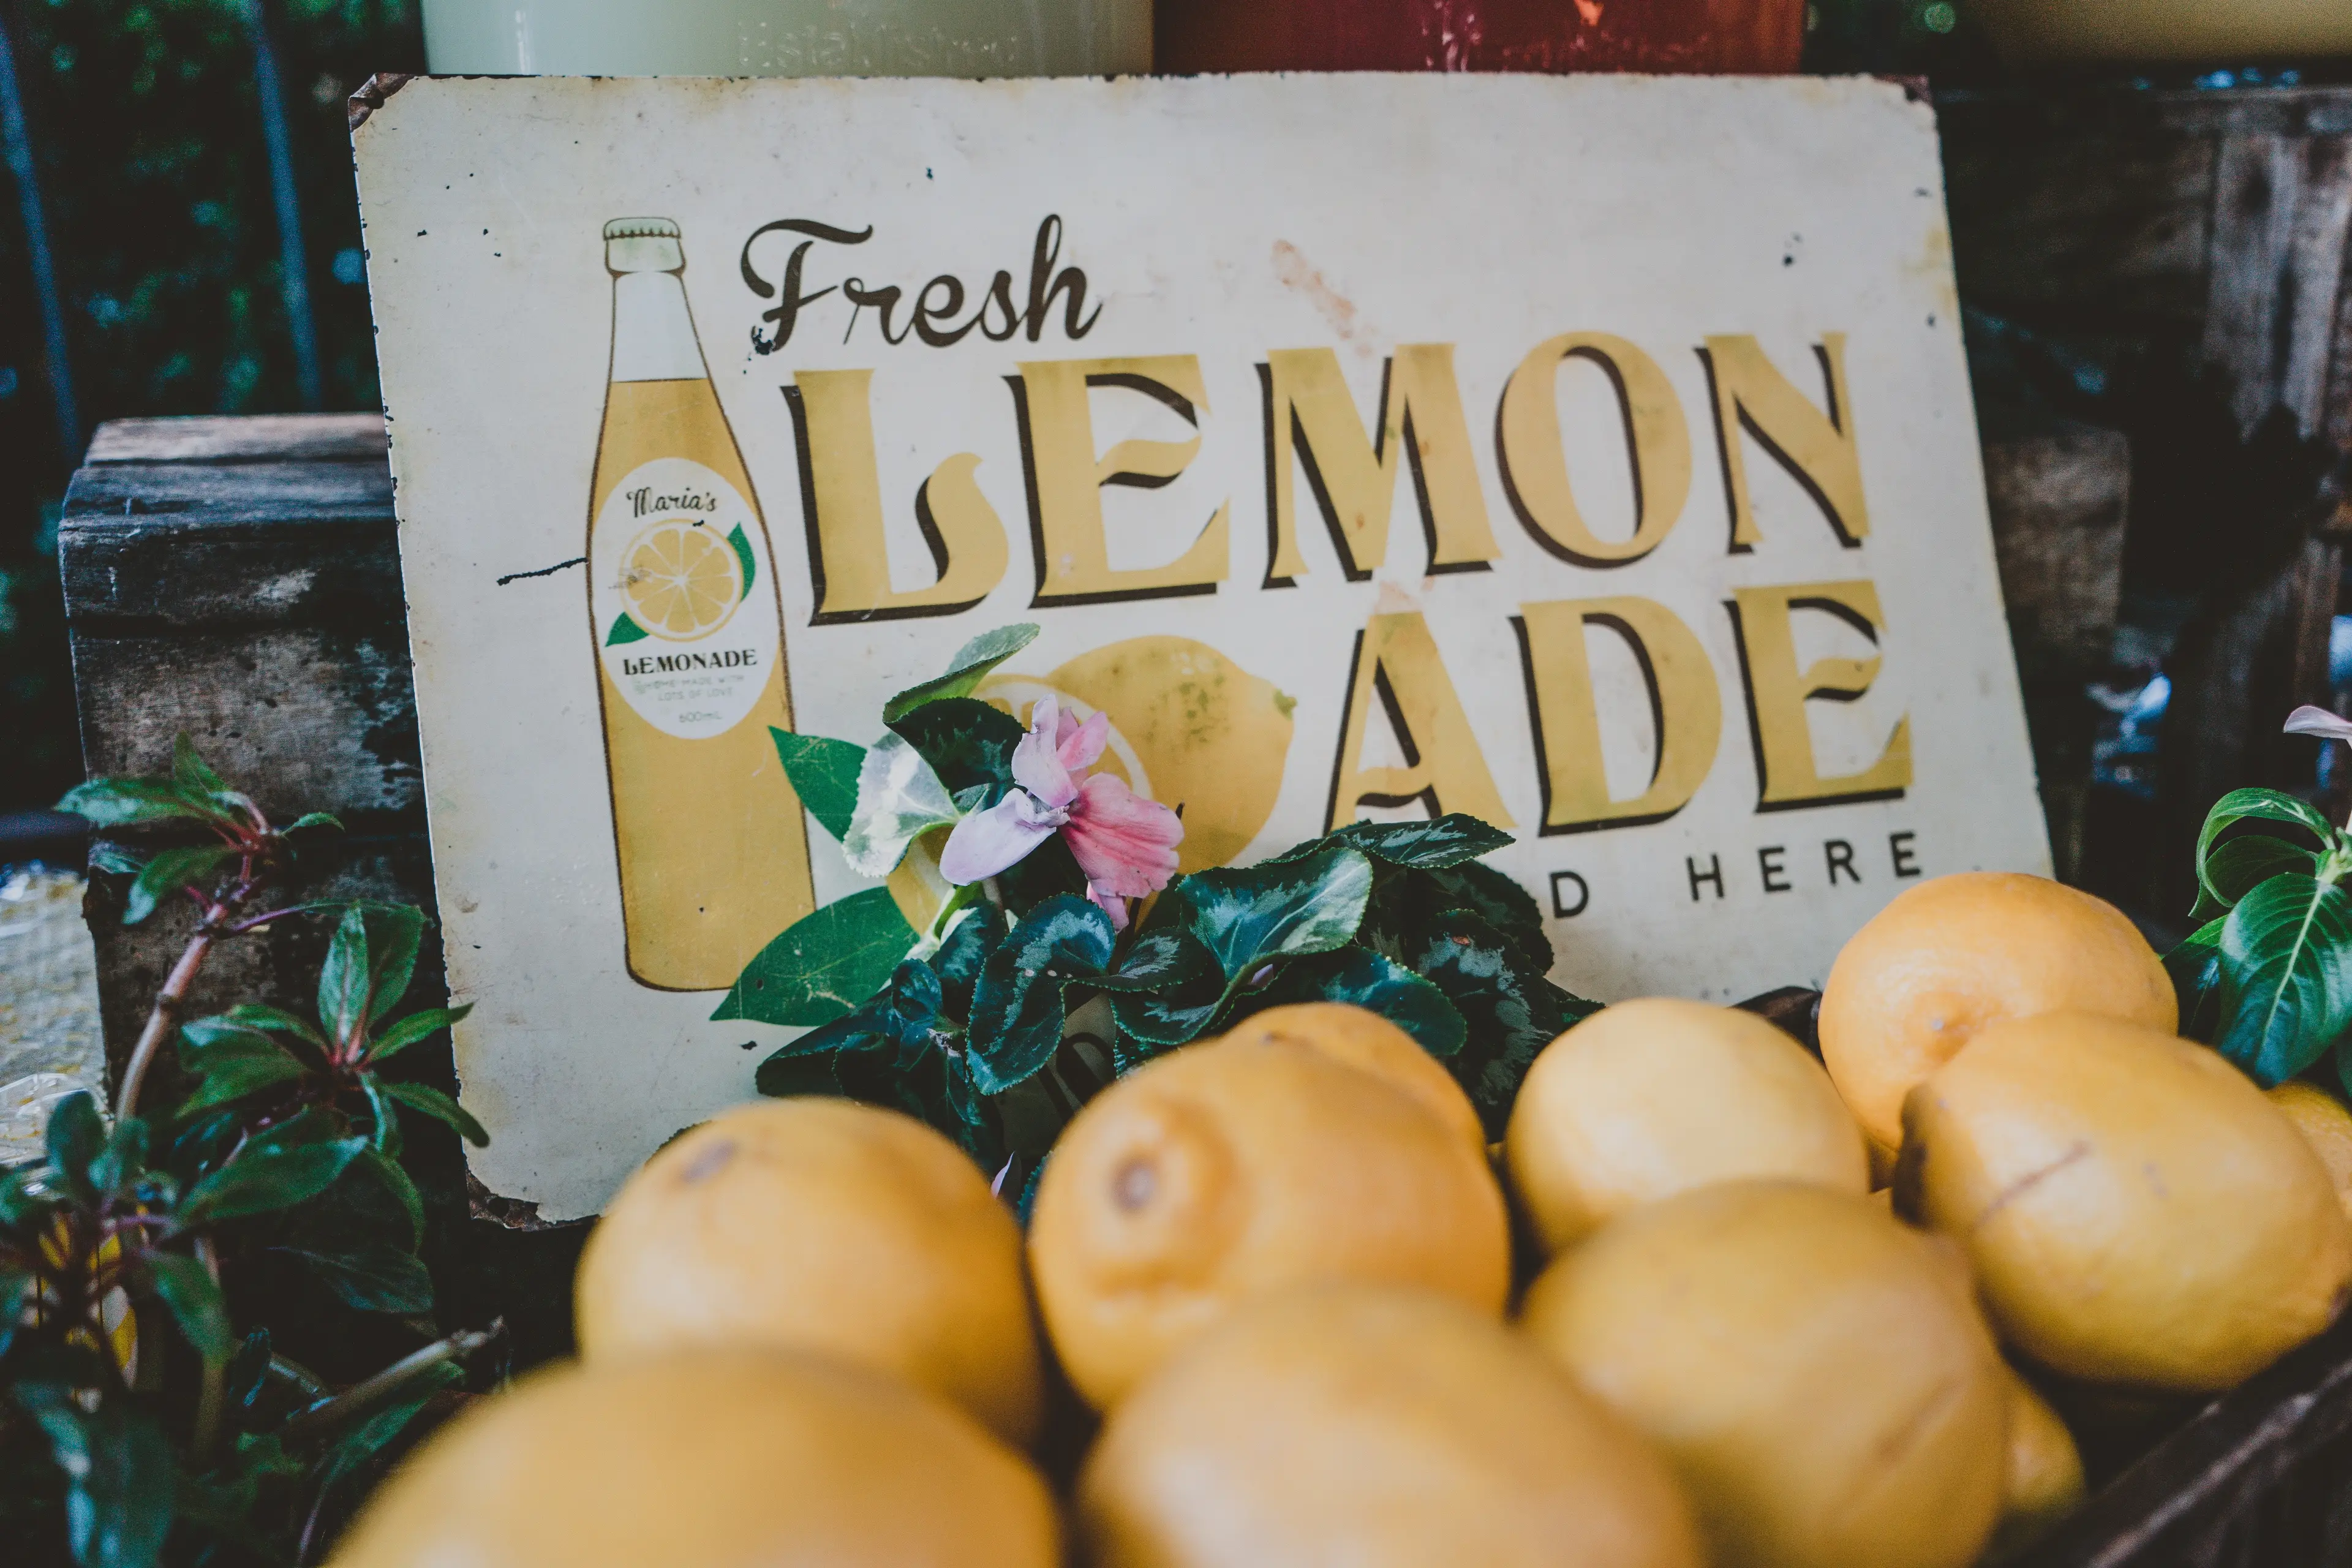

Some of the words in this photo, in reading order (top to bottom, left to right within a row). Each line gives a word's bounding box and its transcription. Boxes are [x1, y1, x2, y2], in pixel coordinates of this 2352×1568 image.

[741, 214, 1102, 355] Fresh
[625, 487, 718, 518] Maria's
[779, 330, 1871, 627] LEMON
[623, 649, 758, 675] LEMONADE
[1323, 579, 1913, 838] ADE
[1685, 831, 1923, 902] HERE
